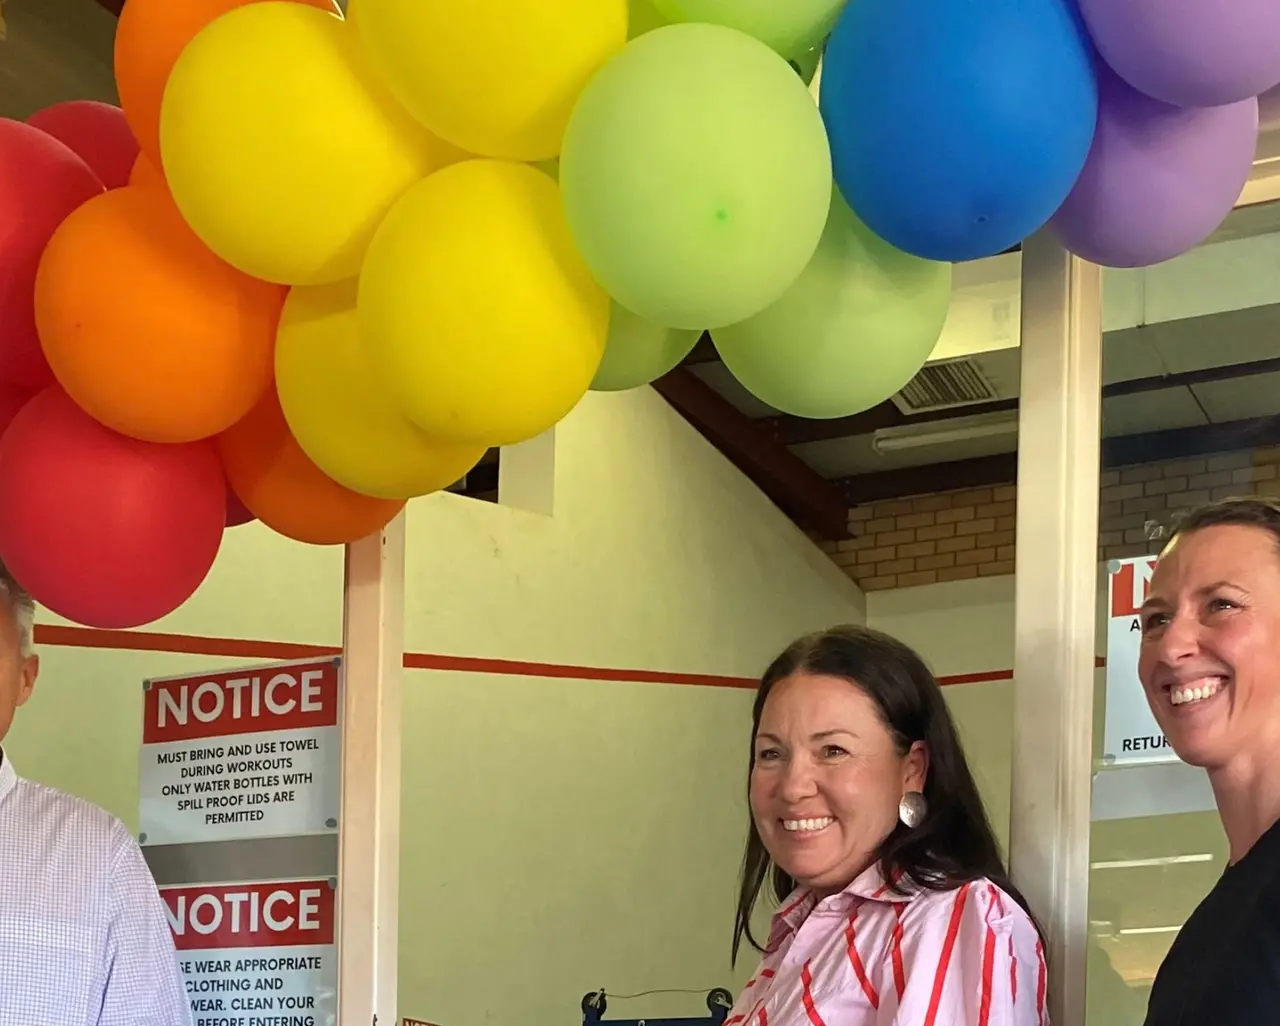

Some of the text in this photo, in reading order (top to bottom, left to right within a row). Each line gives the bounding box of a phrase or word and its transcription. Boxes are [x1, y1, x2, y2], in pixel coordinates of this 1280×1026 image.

[157, 670, 324, 728] NOTICE
[157, 738, 319, 765] MUST BRING AND USE TOWEL
[1122, 735, 1172, 752] RETUR
[181, 757, 293, 778] DURING WORKOUTS
[162, 772, 313, 796] ONLY WATER BOTTLES WITH
[177, 790, 295, 811] SPILL PROOF LIDS ARE
[205, 810, 264, 825] PERMITTED
[160, 888, 321, 935] NOTICE
[195, 960, 231, 973] WEAR
[235, 956, 322, 972] APPROPRIATE
[185, 978, 284, 992] CLOTHING AND
[191, 996, 315, 1012] WEAR. CLEAN YOUR
